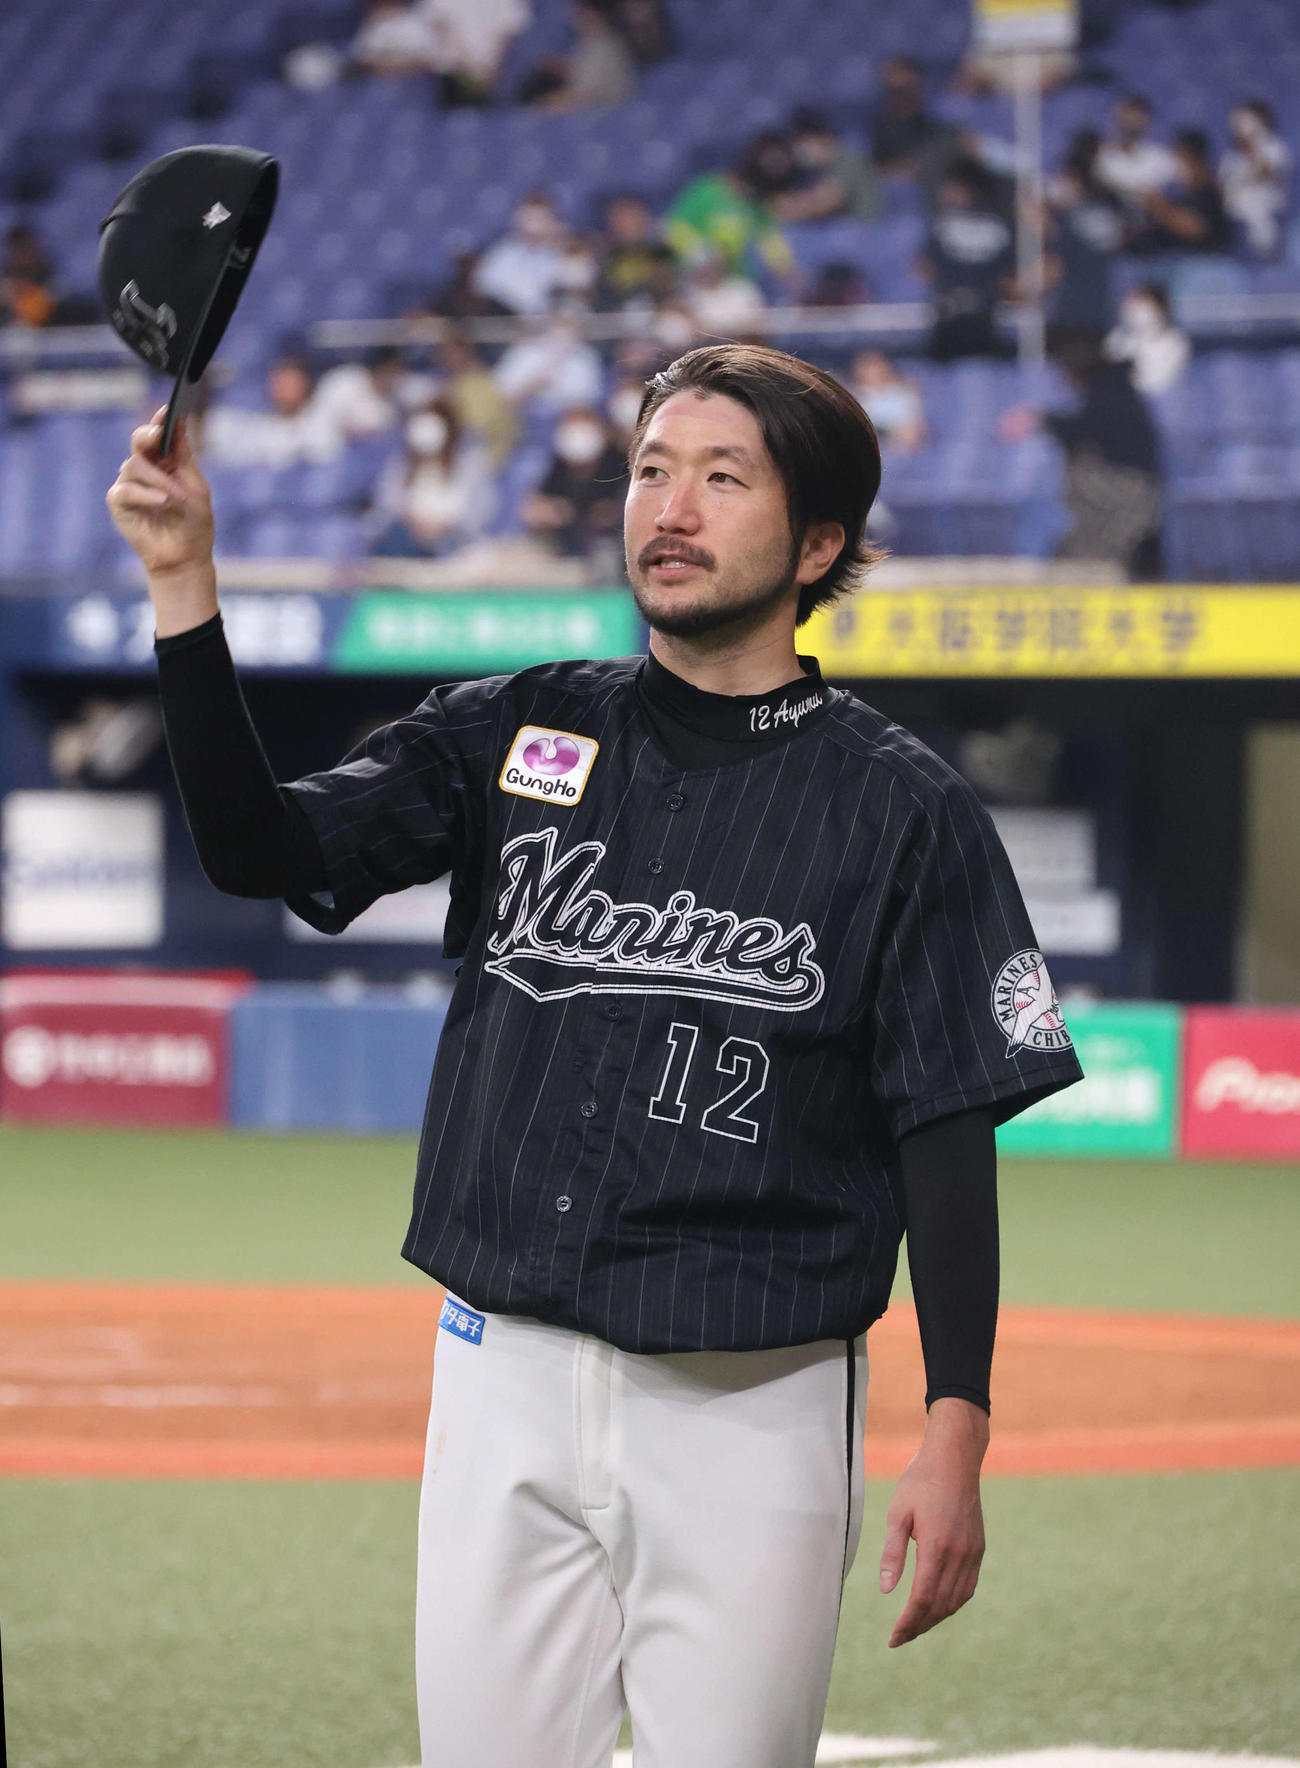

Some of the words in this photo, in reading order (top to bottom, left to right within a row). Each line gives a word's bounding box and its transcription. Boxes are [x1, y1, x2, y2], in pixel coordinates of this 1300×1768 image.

[749, 705, 771, 732] 12
[506, 768, 577, 797] GungHo
[486, 827, 825, 996] Marines
[996, 953, 1038, 1022] MARINES
[648, 1022, 770, 1144] 12
